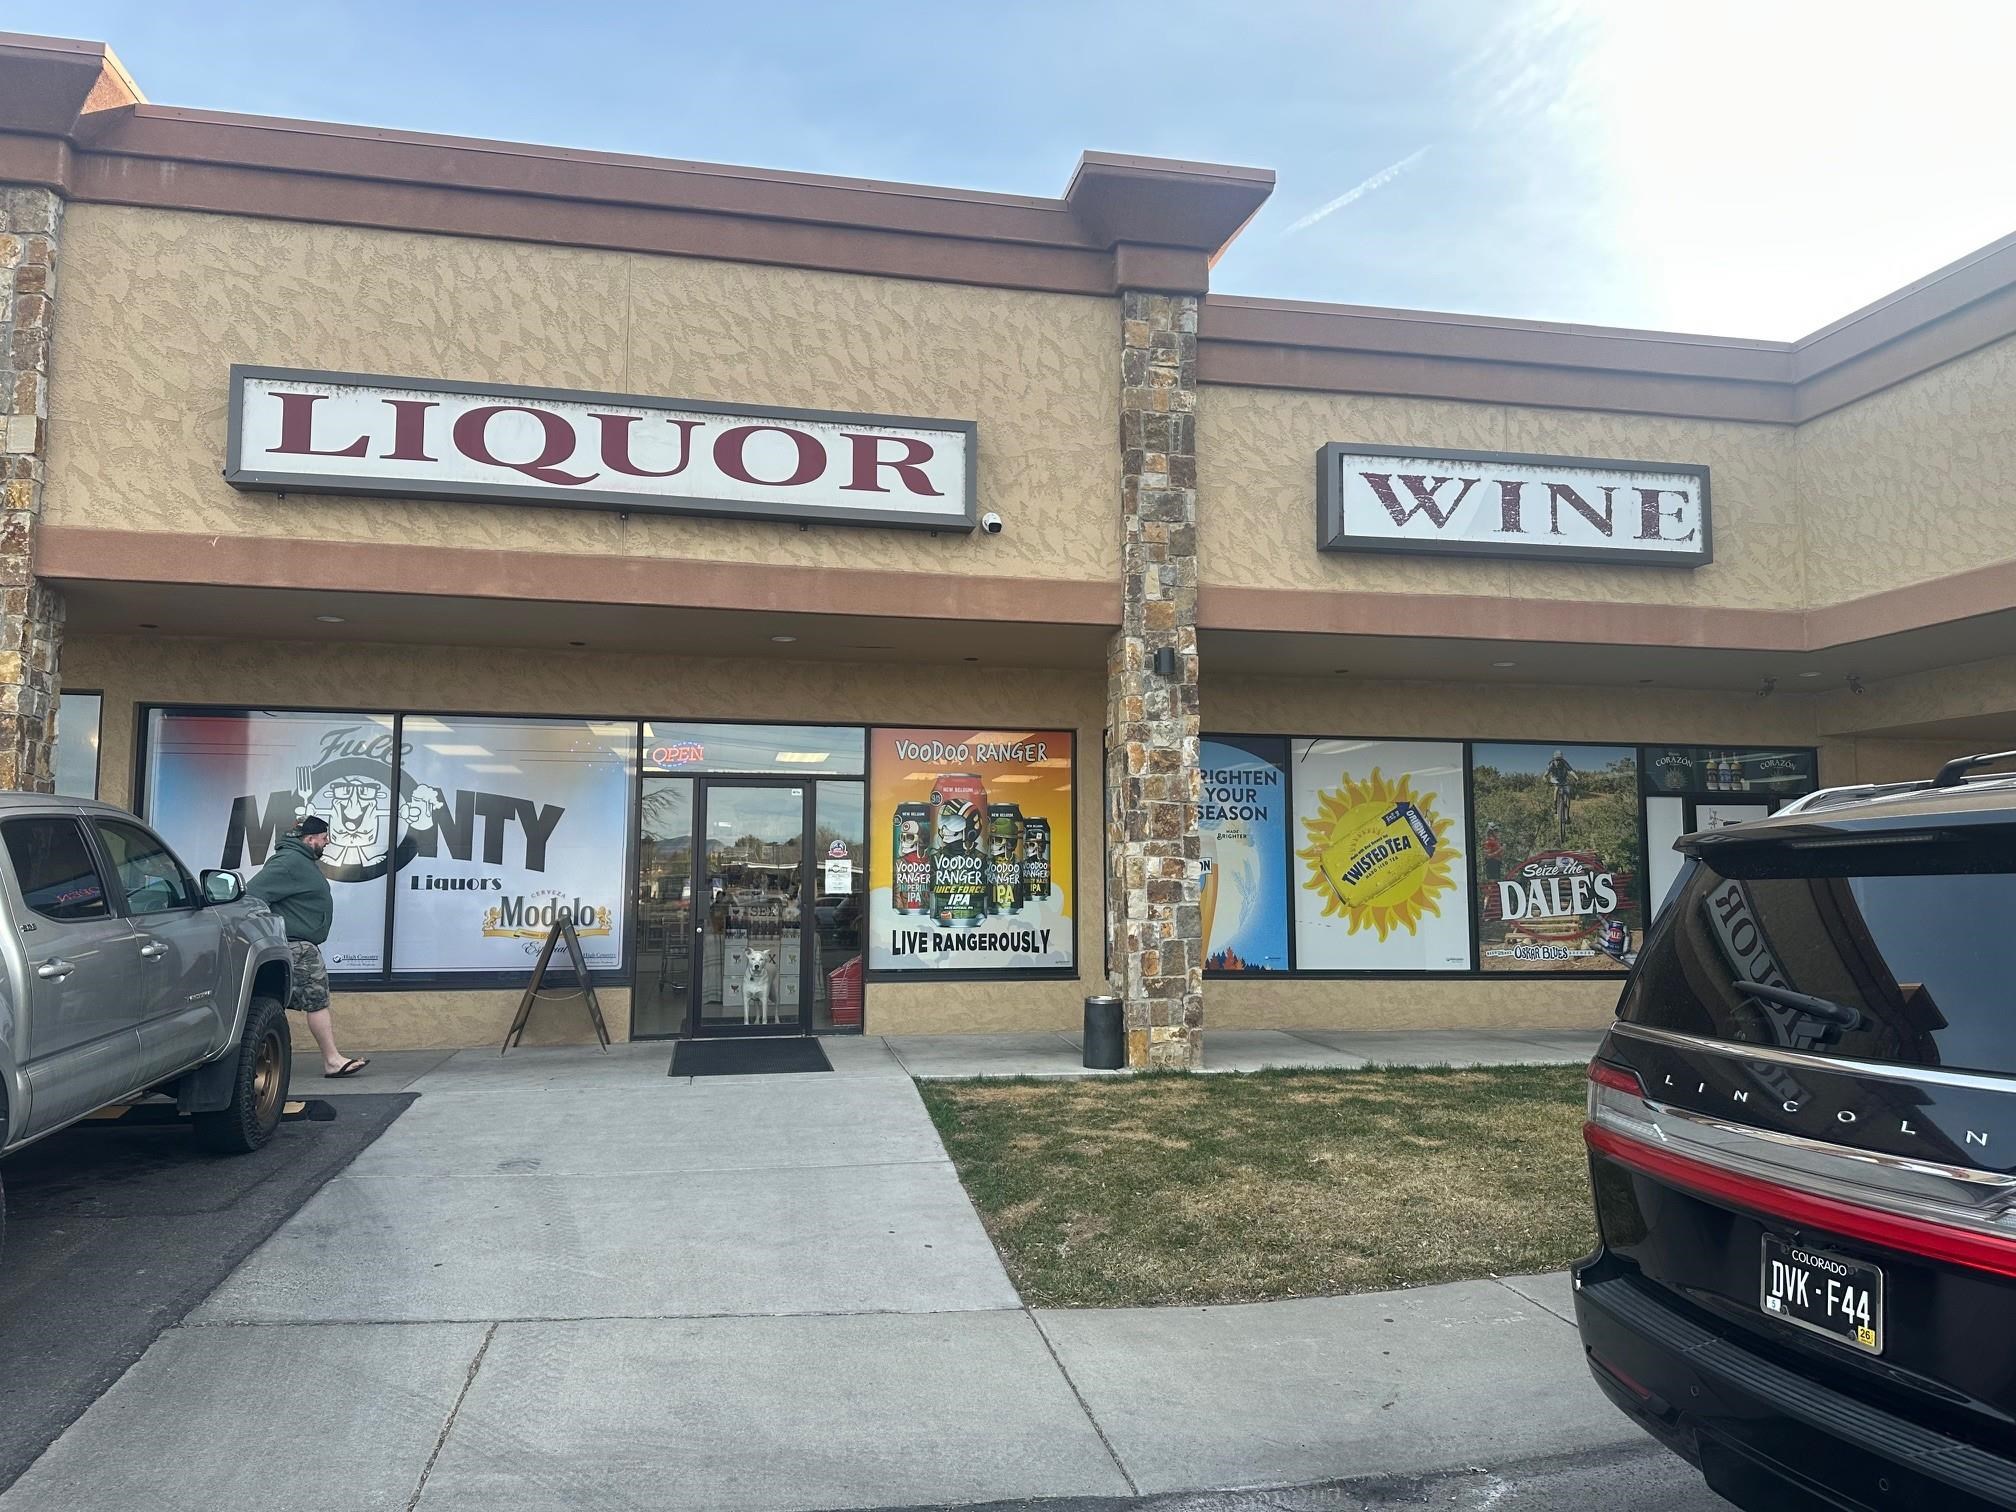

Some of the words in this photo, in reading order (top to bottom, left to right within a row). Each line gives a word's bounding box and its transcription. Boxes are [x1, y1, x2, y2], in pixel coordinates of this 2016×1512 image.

[265, 392, 945, 496] LIQUOR
[1358, 472, 1695, 541] WINE
[652, 746, 704, 763] OPEN
[895, 740, 969, 761] VOODOO
[976, 742, 1048, 762] RANGER
[1200, 769, 1277, 785] RIGHTEN
[1205, 787, 1257, 803] YOUR
[1197, 804, 1267, 821] SEASON
[1406, 810, 1431, 846] ORIGINAL
[1216, 832, 1248, 841] BRIGHTER
[896, 860, 930, 873] VOODOO
[934, 855, 982, 870] VOODOO
[987, 861, 1020, 873] VOODOO
[1023, 861, 1048, 870] VOODOO
[1341, 844, 1389, 886] TWISTED
[1384, 835, 1412, 855] TEA
[1023, 869, 1049, 879] RANGER
[1523, 863, 1559, 878] Seize
[1563, 860, 1583, 875] the
[411, 875, 502, 891] Liquors
[896, 873, 931, 884] RANGER
[935, 870, 983, 886] RANGER
[986, 873, 1020, 885] RANGER
[530, 888, 566, 899] CERVEZA
[957, 885, 986, 894] FORCE
[992, 884, 1015, 903] IPA
[1030, 883, 1041, 892] IPA
[907, 892, 921, 903] IPA
[947, 893, 971, 906] IPA
[1497, 871, 1618, 921] DALE'S
[892, 929, 928, 955] LIVE
[932, 929, 1050, 954] RANGEROUSLY
[1514, 945, 1541, 960] OSKAR
[1542, 946, 1569, 959] BLUES
[1665, 1074, 1988, 1147] LINCOLN
[1791, 1250, 1848, 1276] COLORADO
[1860, 1328, 1871, 1341] 26
